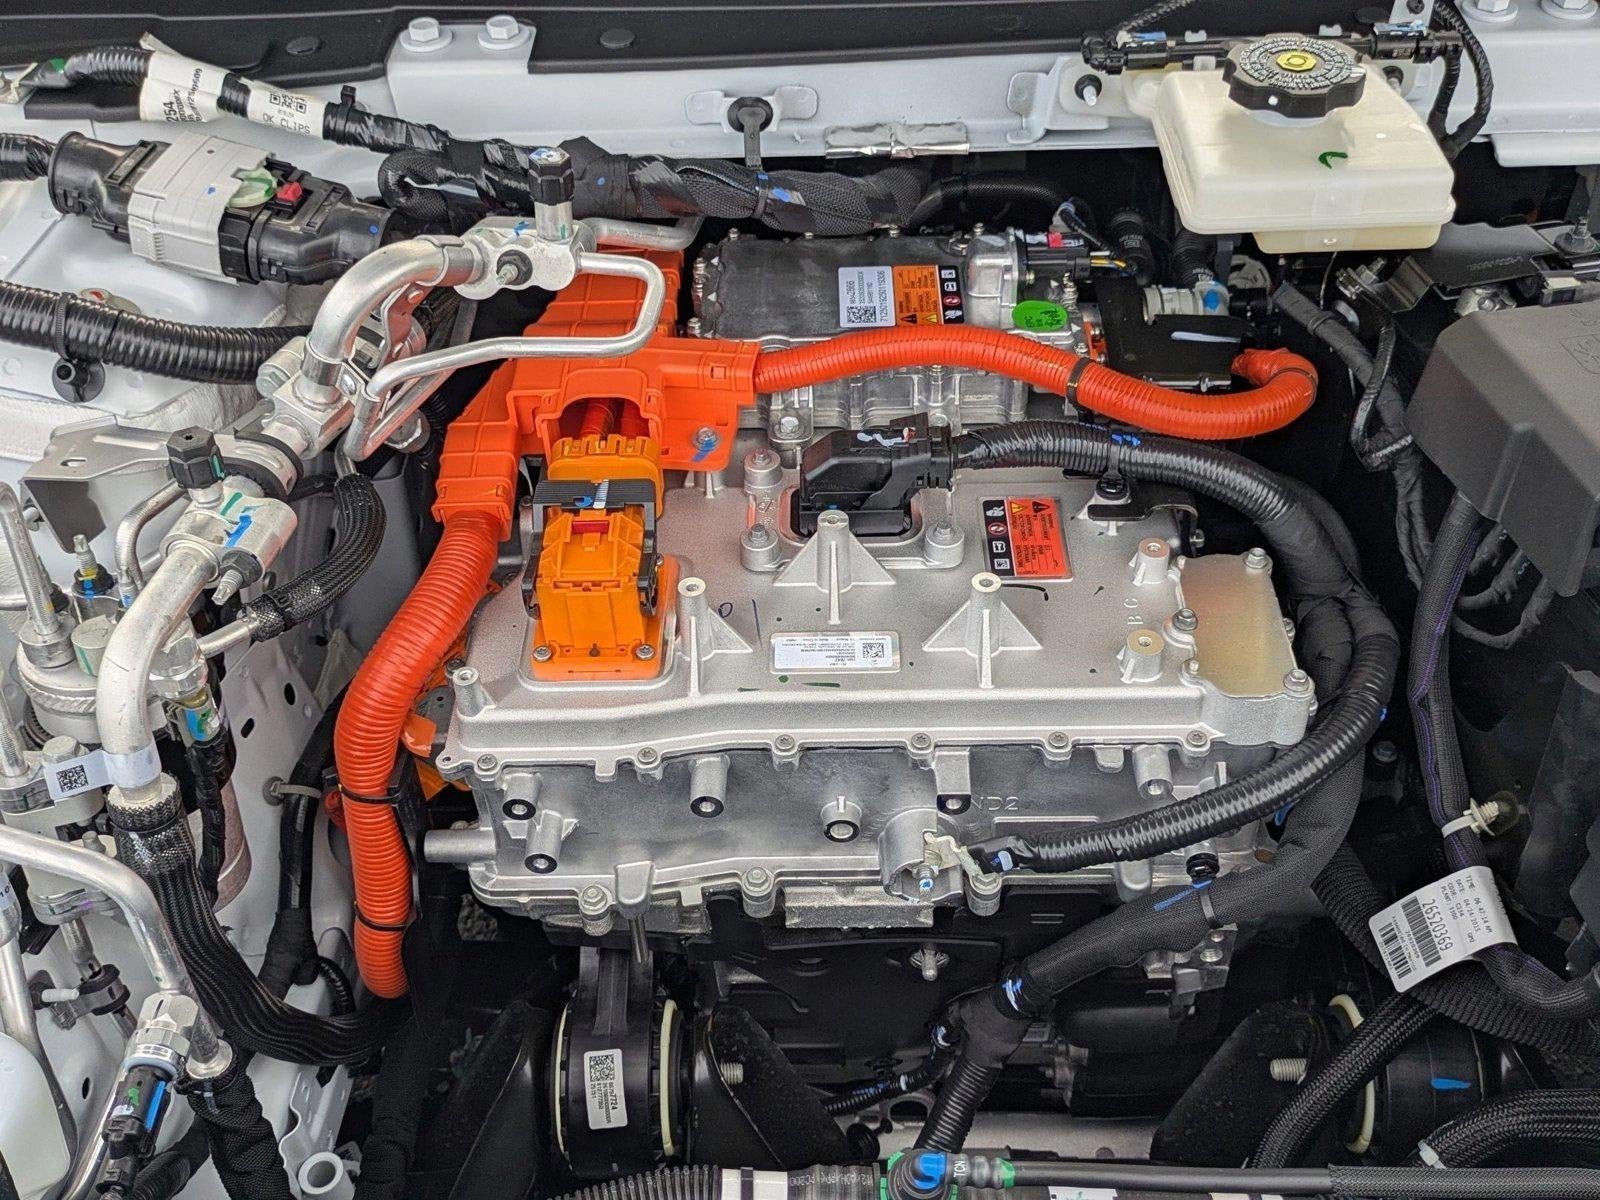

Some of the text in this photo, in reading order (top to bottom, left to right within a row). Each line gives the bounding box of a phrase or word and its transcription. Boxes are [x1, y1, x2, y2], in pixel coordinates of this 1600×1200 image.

[262, 112, 274, 123] OK
[280, 118, 311, 135] CLIPS
[1421, 898, 1453, 952] 26520369
[954, 1160, 967, 1177] TCN
